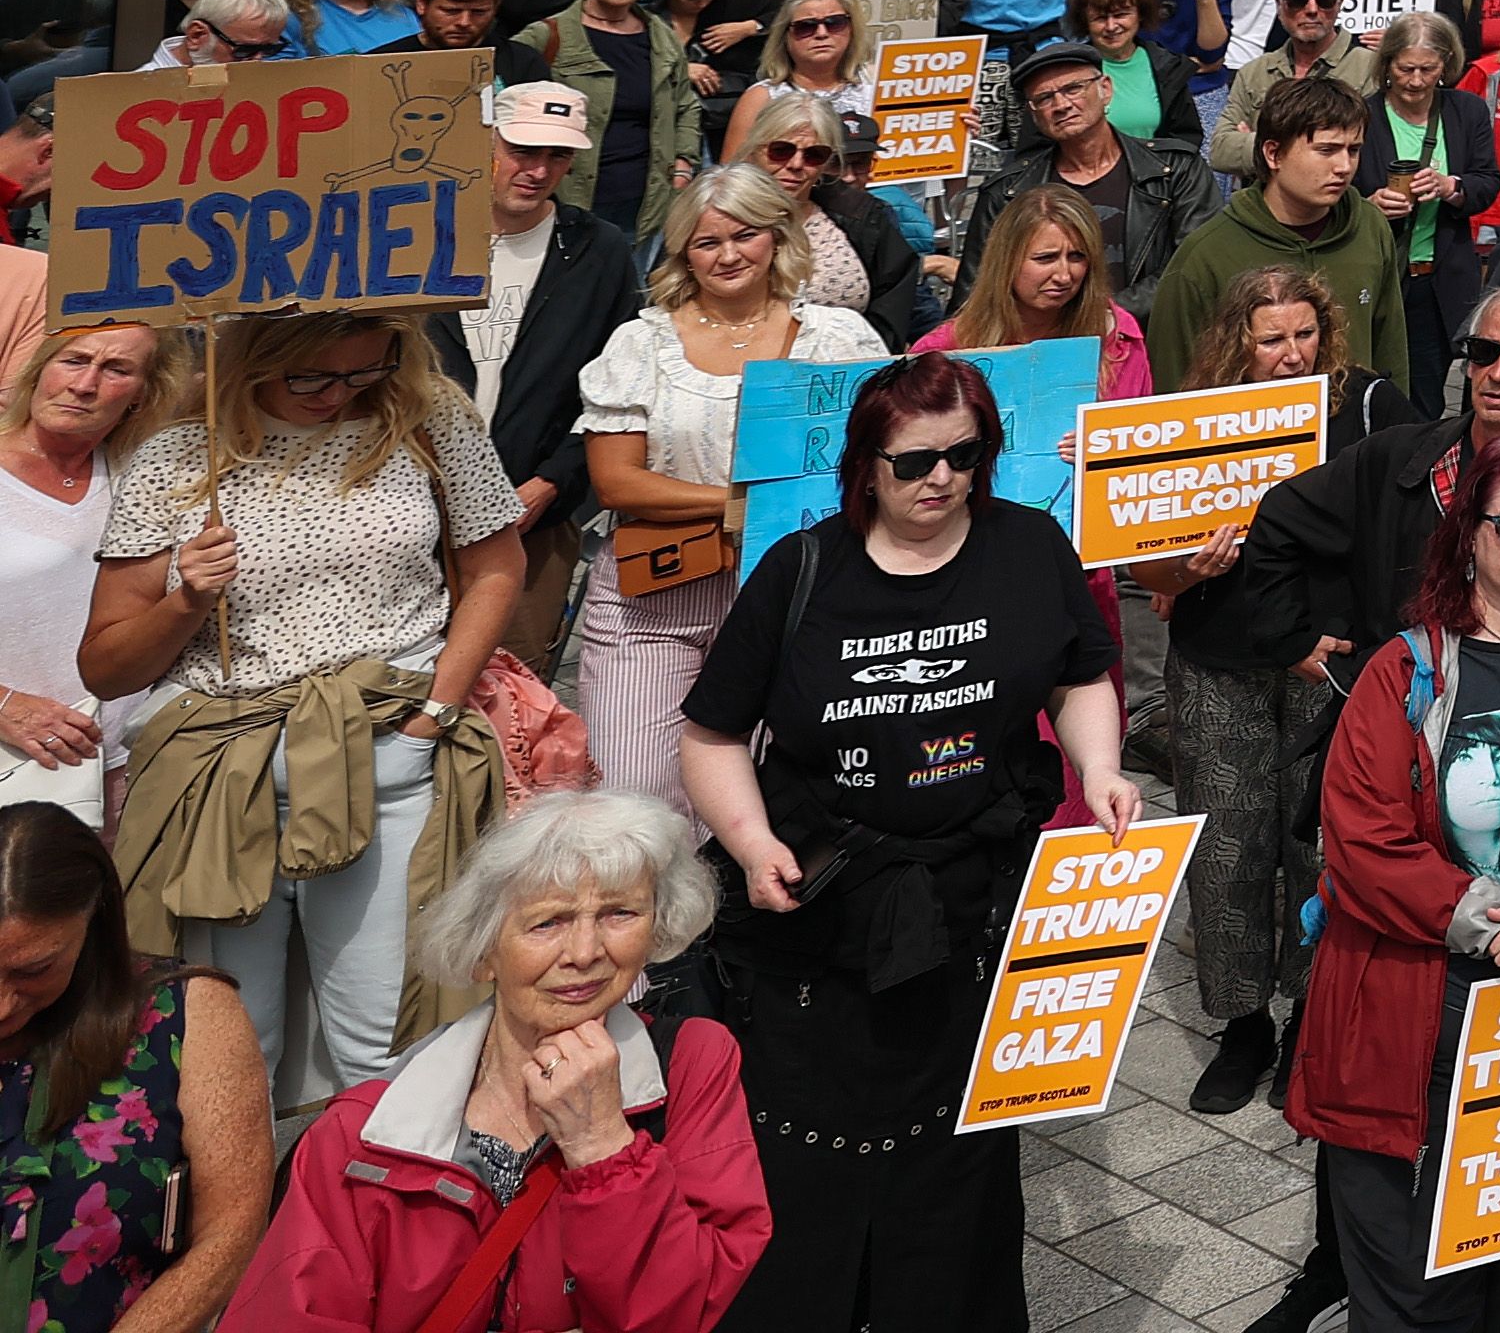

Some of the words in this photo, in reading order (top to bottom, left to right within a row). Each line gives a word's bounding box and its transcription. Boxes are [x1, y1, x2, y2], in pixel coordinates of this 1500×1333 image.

[892, 52, 966, 75] STOP
[878, 74, 974, 99] TRUMP
[90, 86, 349, 191] STOP
[883, 110, 955, 134] FREE
[60, 180, 486, 315] ISRAEL
[1087, 420, 1185, 454] STOP
[1193, 403, 1316, 441] TRUMP
[1107, 452, 1296, 501] MIGRANTS
[840, 630, 913, 661] ELDER
[918, 618, 988, 652] GOTHS
[822, 692, 909, 722] AGAINST
[910, 679, 996, 713] FASCISM
[920, 731, 977, 765] YAS
[907, 756, 986, 788] QUEENS
[1046, 848, 1164, 895] STOP
[1020, 893, 1165, 946] TRUMP
[1010, 969, 1121, 1021] FREE
[991, 1020, 1104, 1072] GAZA
[1455, 1236, 1488, 1253] STOP
